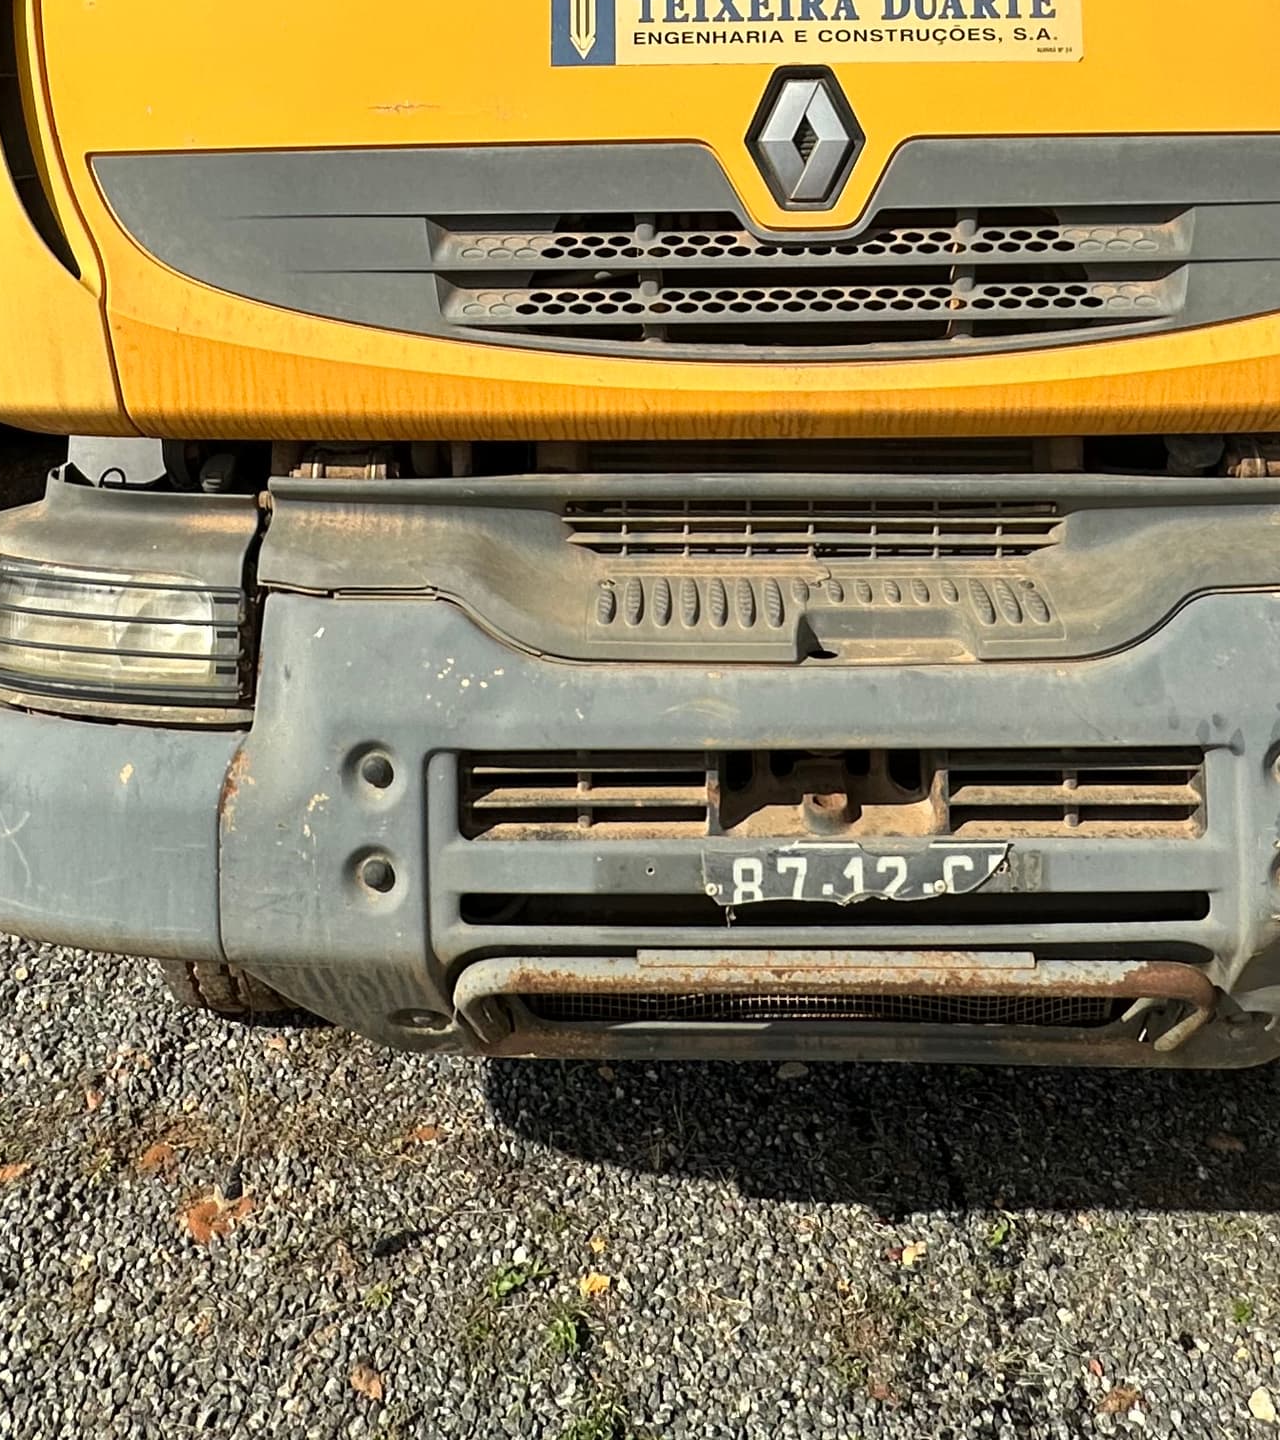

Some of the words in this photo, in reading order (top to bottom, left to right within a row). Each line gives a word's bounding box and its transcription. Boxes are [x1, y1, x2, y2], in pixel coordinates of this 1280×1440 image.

[633, 30, 784, 45] ENGENHARIA
[794, 30, 808, 43] E
[817, 25, 1004, 45] CONSTRUÇÕES,
[1013, 27, 1059, 41] S.A.
